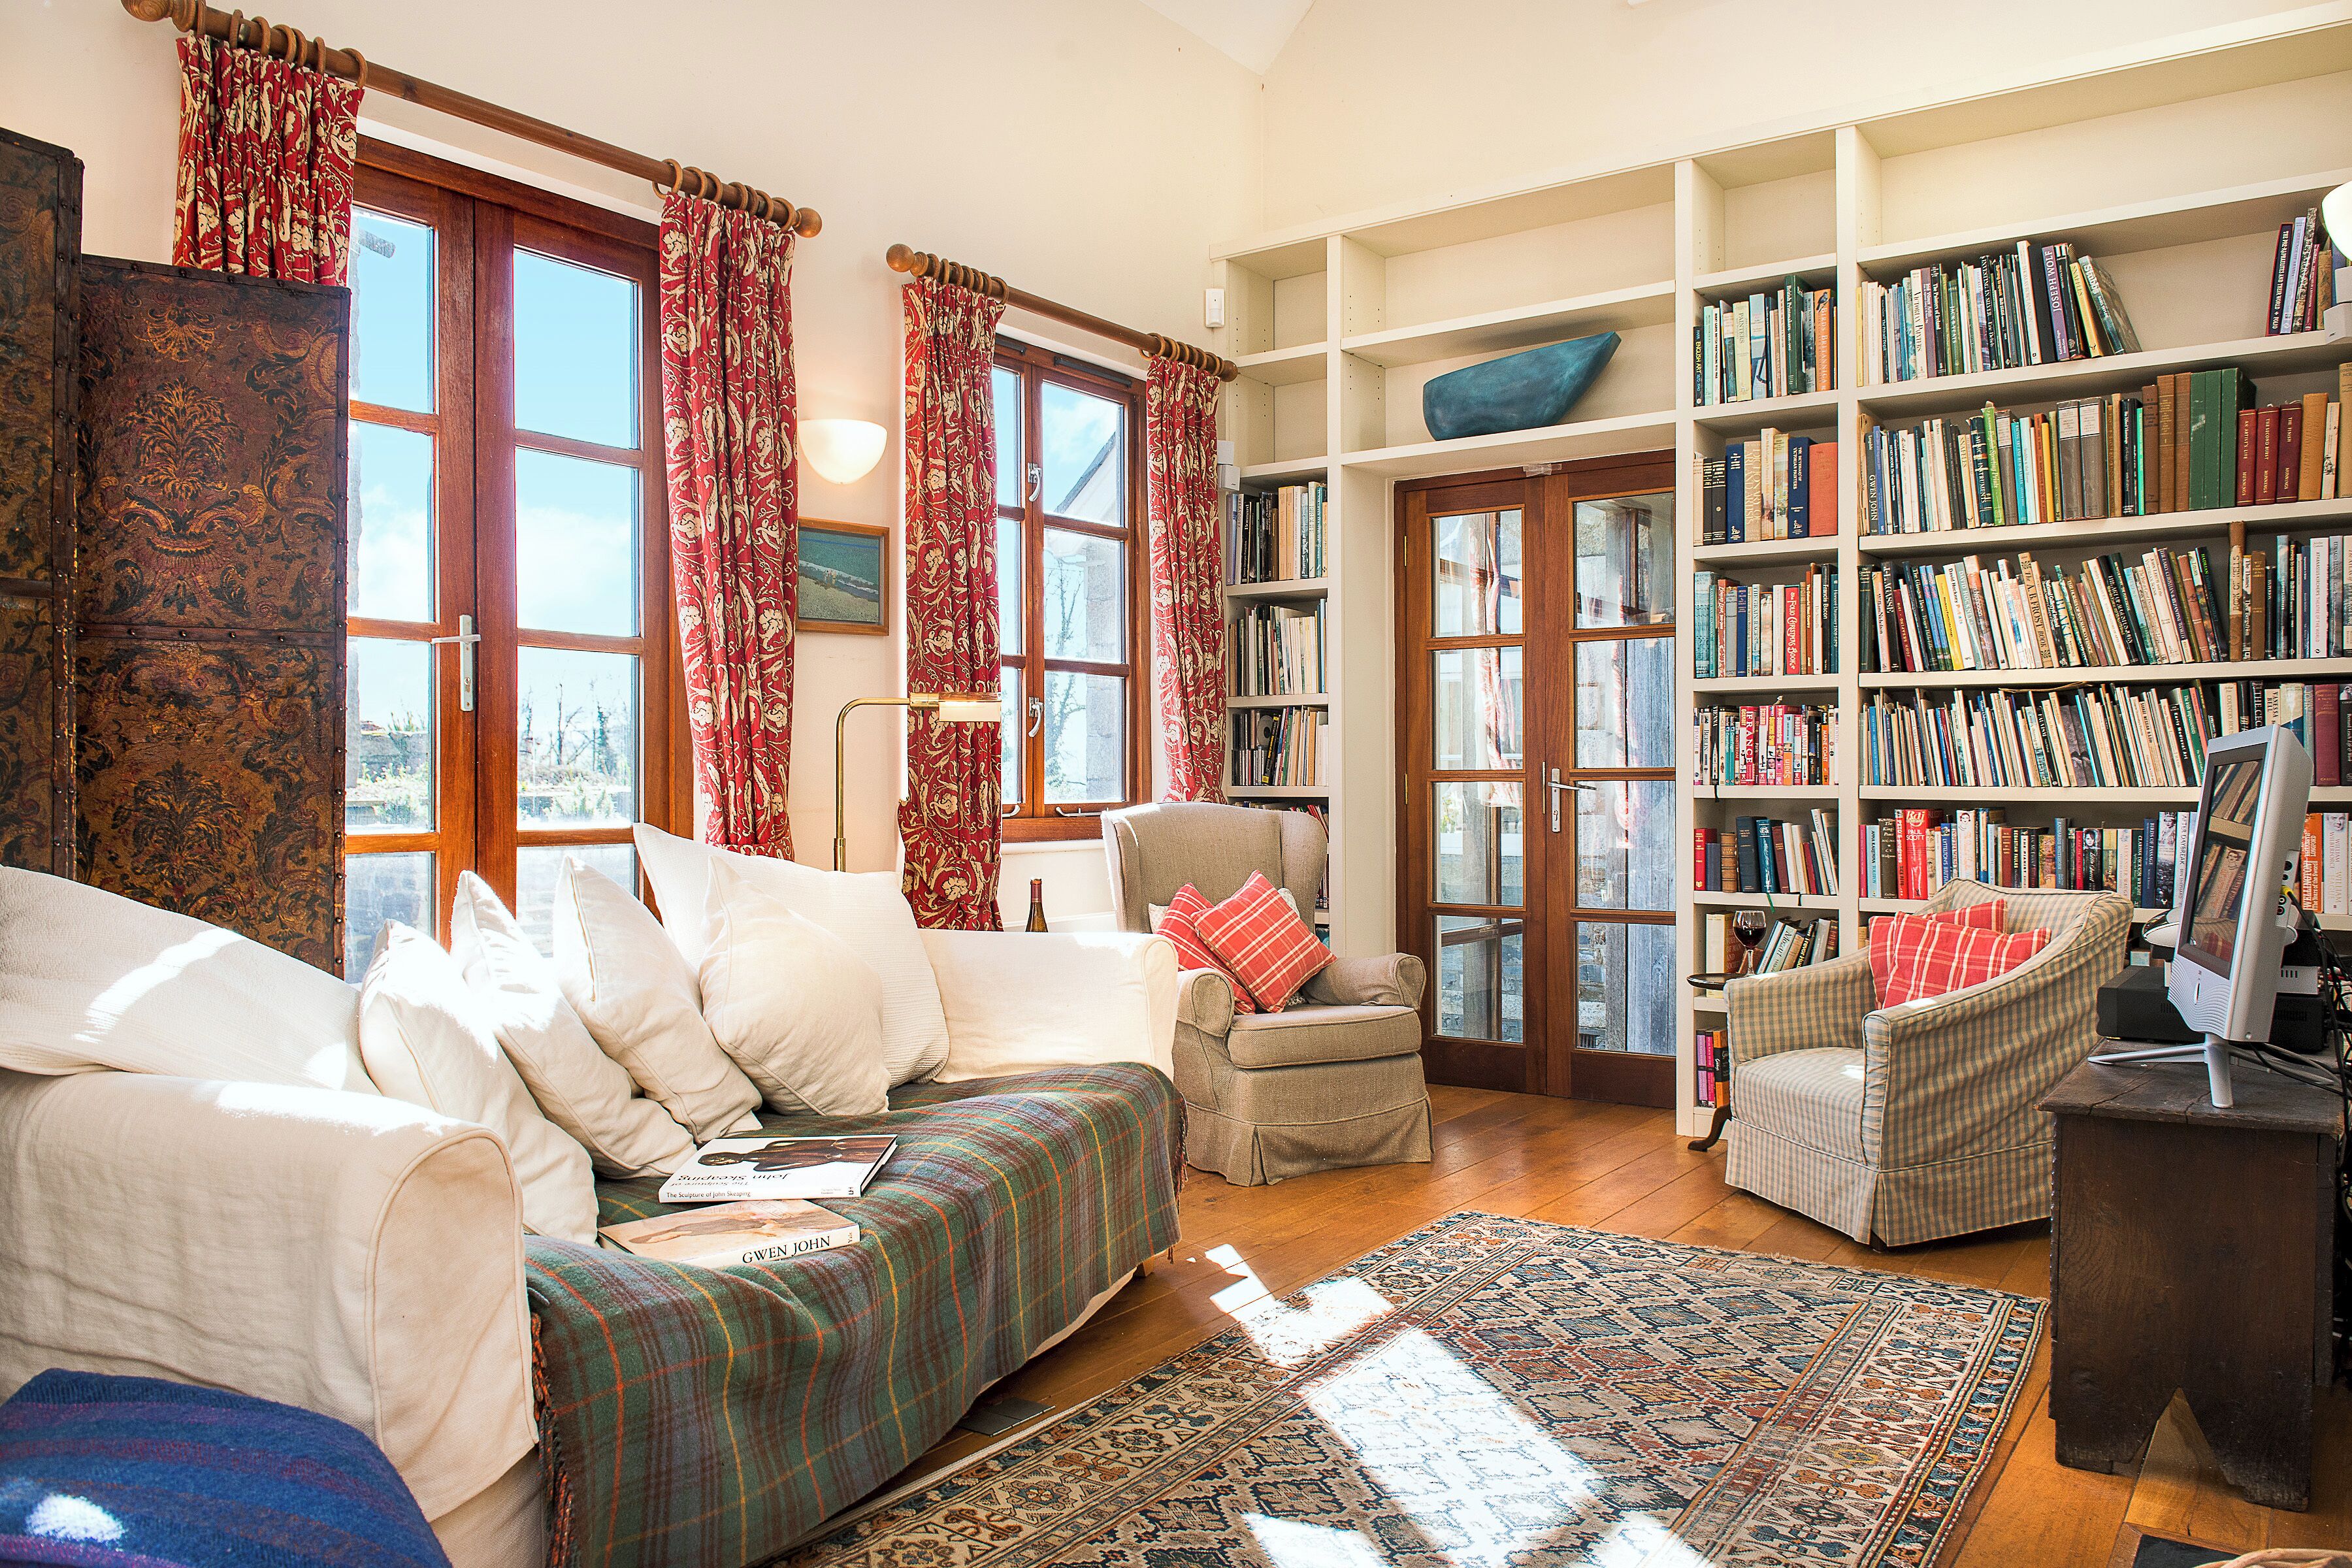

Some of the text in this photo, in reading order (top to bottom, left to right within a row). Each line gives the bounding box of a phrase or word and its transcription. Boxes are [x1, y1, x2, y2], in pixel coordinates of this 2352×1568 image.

[2278, 239, 2288, 274] PRE-RAPHAELITES
[2045, 250, 2061, 312] JOSEPH WOLF
[2083, 265, 2100, 295] Stubbs
[1913, 291, 1923, 352] VICTORIAN PAINTERS
[1869, 499, 1878, 521] JOHN
[2200, 553, 2209, 574] HADRIAN
[1950, 582, 1959, 604] Hockney
[1962, 590, 1972, 620] HOCKNEY
[1974, 591, 1983, 617] Nicholson
[2031, 601, 2043, 628] FROST
[2037, 630, 2047, 647] BOOK
[2055, 598, 2072, 637] BLAKE
[1786, 600, 1798, 666] FOLIO CHRISTMAS BOOK
[2037, 713, 2047, 737] FAUVISM
[2177, 727, 2186, 750] Medieval
[1783, 759, 1791, 778] Spain
[1906, 810, 1925, 821] Raj
[2303, 862, 2312, 909] WELLINGTON
[1777, 930, 1792, 956] Mozart
[1800, 938, 1810, 956] Trevor
[742, 1236, 830, 1264] GWEN JOHN
